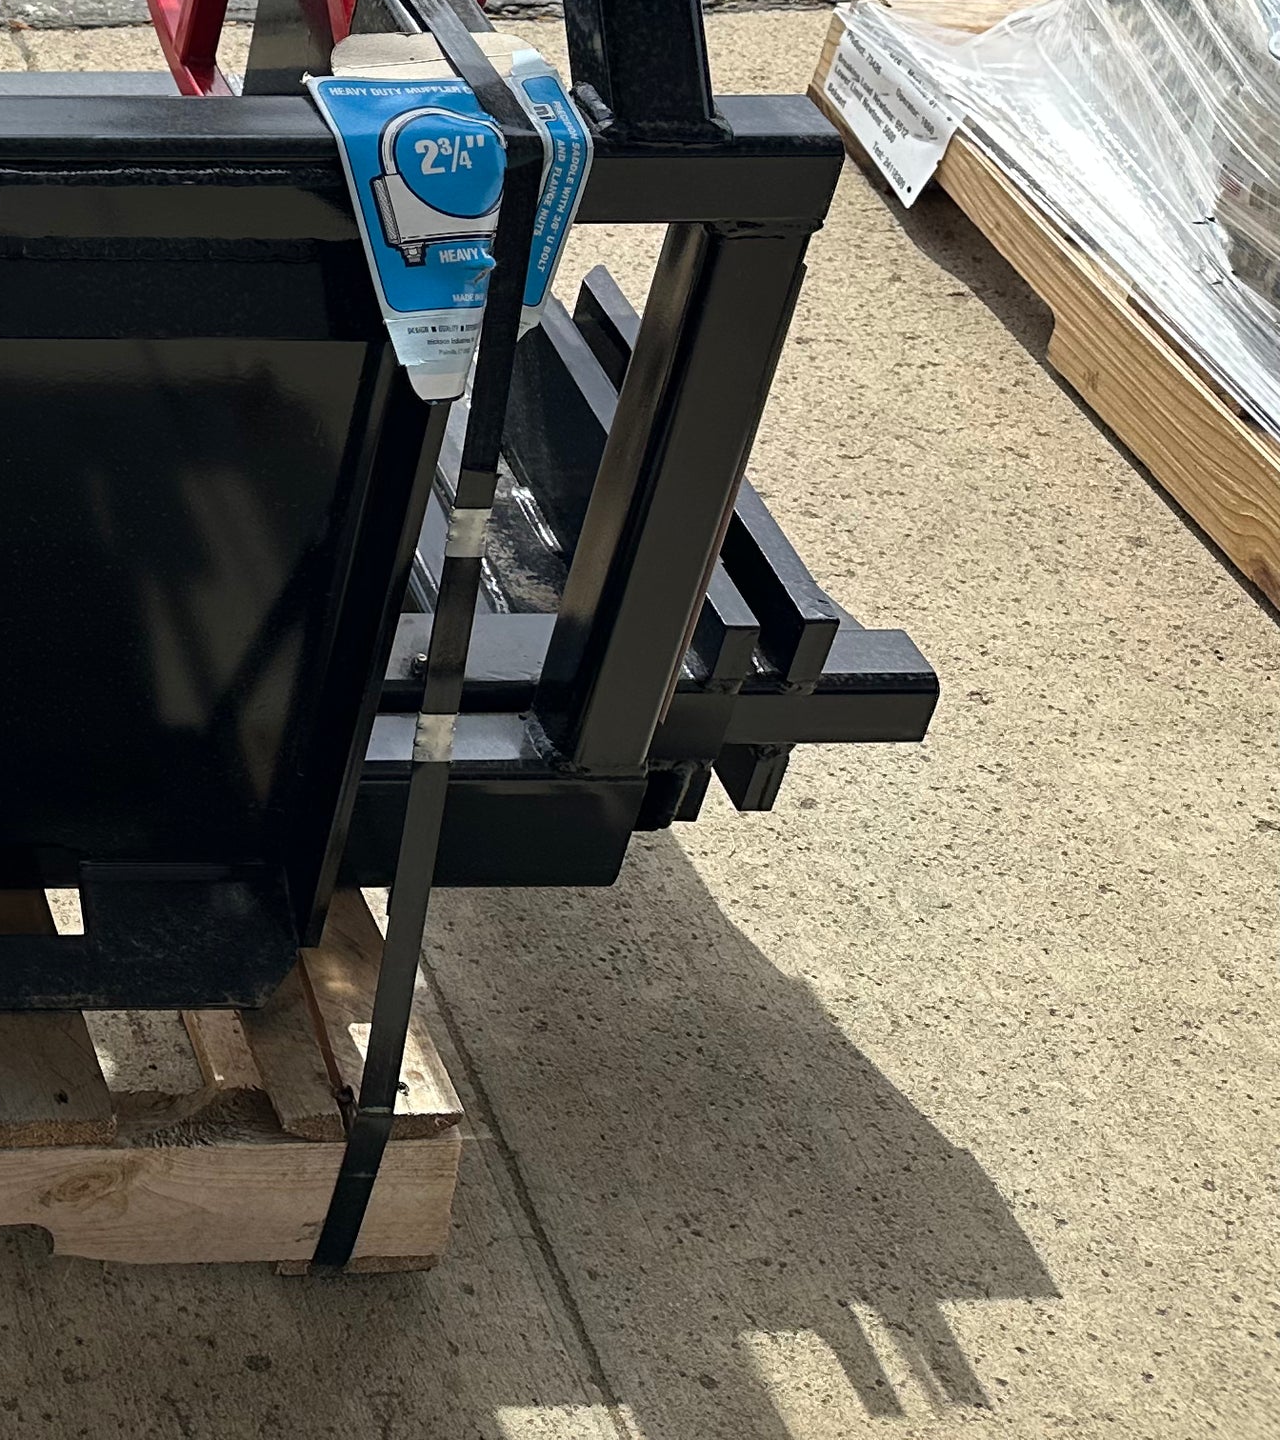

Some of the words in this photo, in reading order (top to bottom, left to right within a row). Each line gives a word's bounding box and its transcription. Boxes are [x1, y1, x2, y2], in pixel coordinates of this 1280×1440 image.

[329, 87, 367, 96] HEAVY
[370, 87, 402, 96] DUTY
[405, 86, 461, 95] MUFFLER
[556, 139, 566, 162] AND
[570, 141, 581, 184] SADDLE
[544, 166, 563, 207] FLANGE
[558, 184, 572, 213] WITH
[534, 209, 549, 237] NUTS
[547, 236, 555, 245] U
[439, 248, 479, 263] HEAVY
[537, 245, 551, 273] BOLT
[452, 294, 474, 302] MADE
